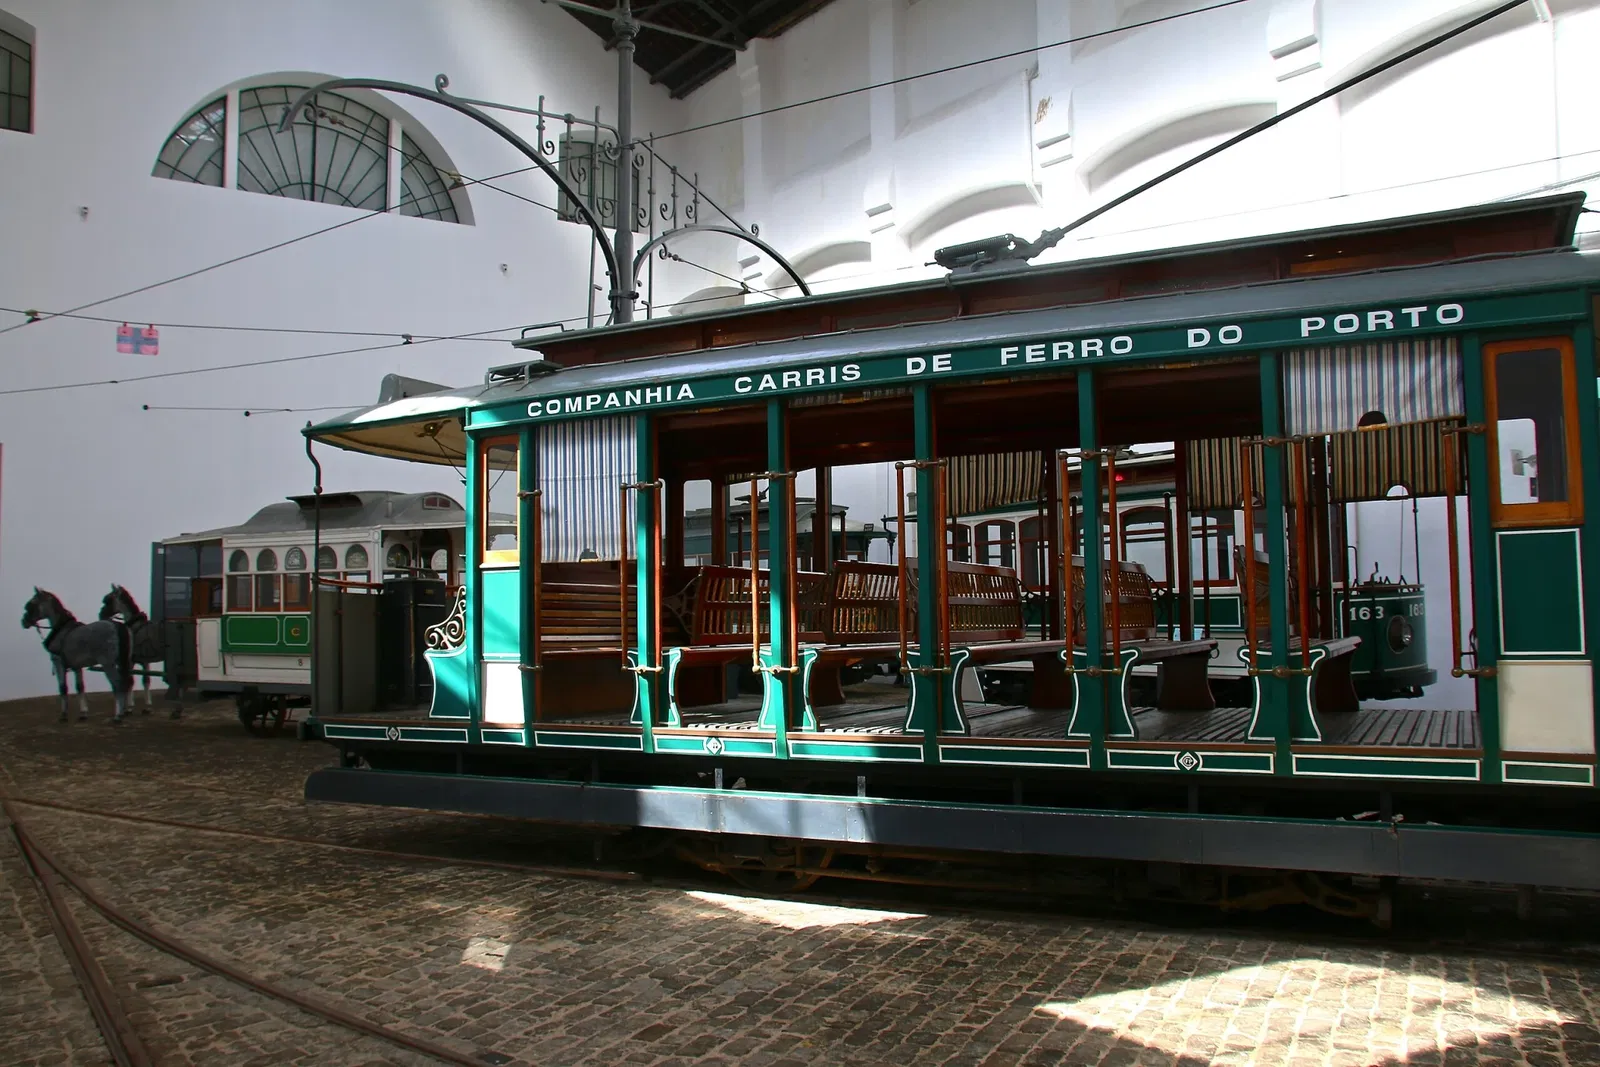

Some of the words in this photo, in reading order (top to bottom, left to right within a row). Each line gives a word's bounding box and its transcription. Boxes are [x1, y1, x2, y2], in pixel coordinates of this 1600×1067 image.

[526, 383, 695, 417] COMPANHIA
[734, 363, 861, 393] CARRIS
[906, 353, 953, 375] DE
[1000, 335, 1134, 366] FERRO
[1187, 325, 1243, 348] DO
[1300, 303, 1465, 337] PORTO
[1349, 605, 1384, 621] 163
